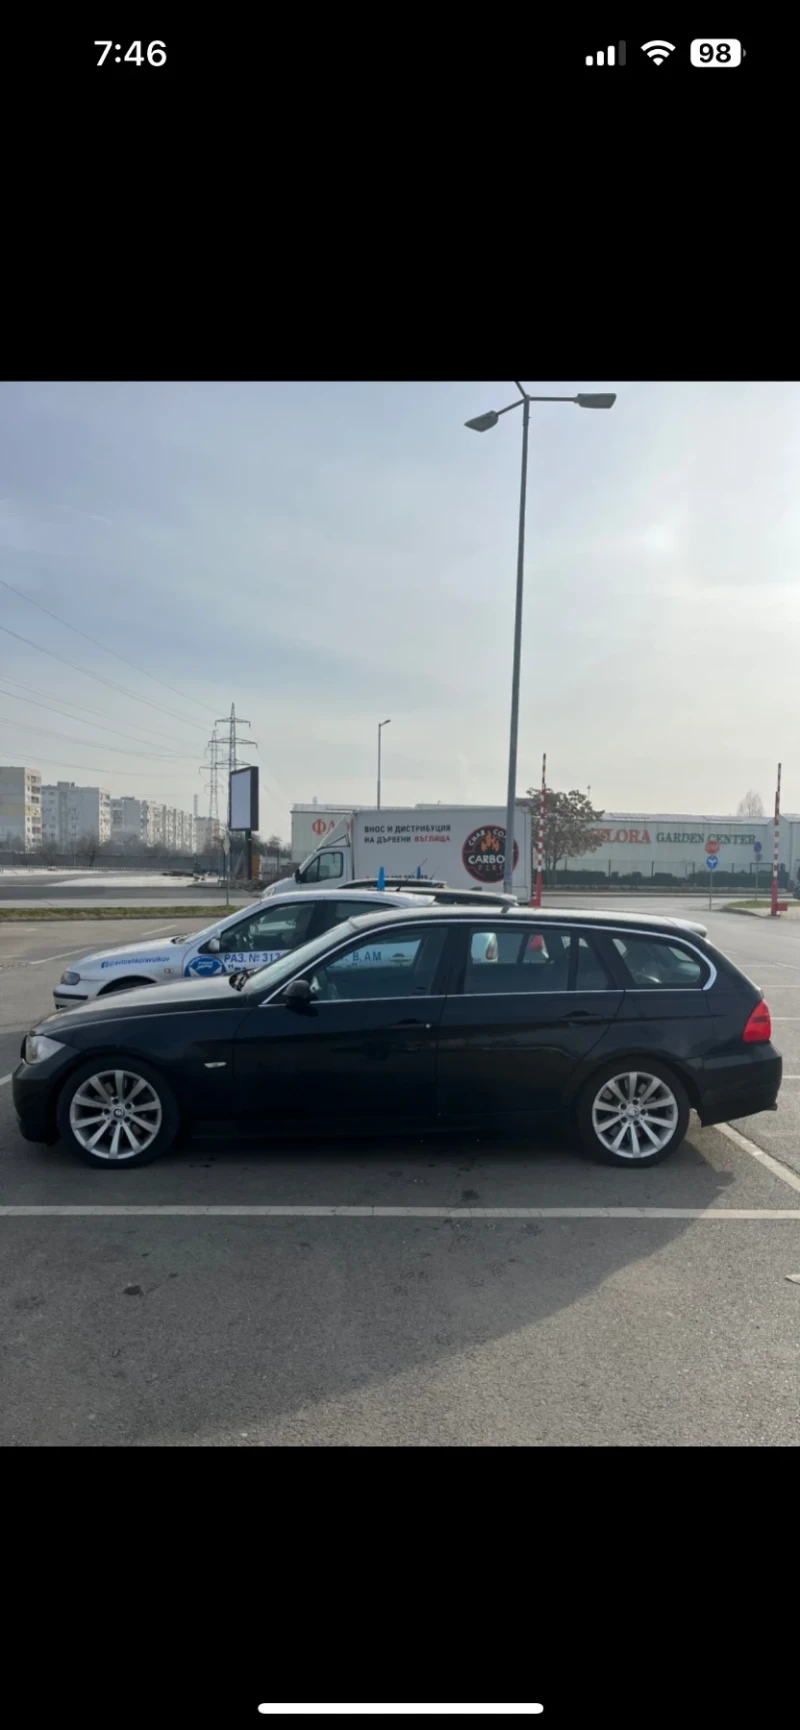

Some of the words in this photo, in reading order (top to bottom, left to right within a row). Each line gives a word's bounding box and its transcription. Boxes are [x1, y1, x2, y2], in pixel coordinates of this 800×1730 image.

[364, 825, 385, 833] ВНОС
[387, 825, 393, 833] И
[395, 824, 451, 834] ДИСТРИБУЦИЯ
[364, 836, 375, 844] НА
[377, 836, 411, 845] ДЪРВЕНИ
[414, 835, 450, 843] ВЪГЛИЩА
[468, 829, 486, 847] CHAR
[656, 832, 704, 844] GARDEN
[707, 833, 756, 845] CENTER
[468, 854, 506, 865] CARBO
[224, 952, 247, 963] РАЗ.
